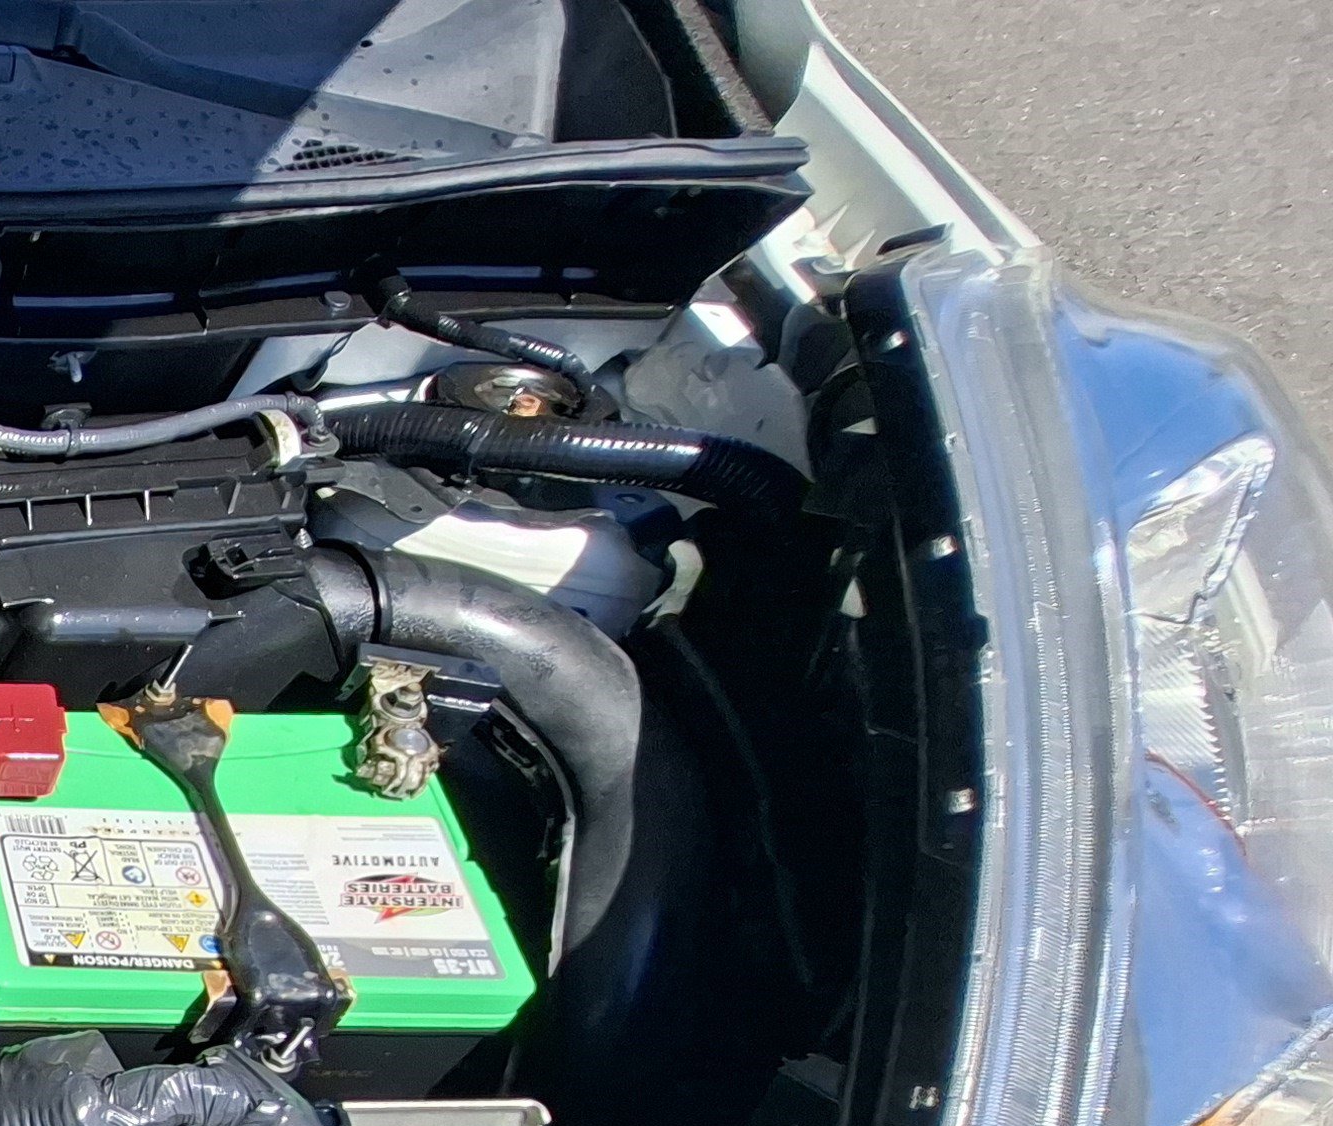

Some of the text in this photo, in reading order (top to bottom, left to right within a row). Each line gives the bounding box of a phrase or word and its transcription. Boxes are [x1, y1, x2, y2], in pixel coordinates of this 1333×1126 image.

[333, 855, 440, 867] AUTOMOTIVE
[348, 883, 452, 894] BATTERIES
[343, 895, 460, 906] INTERSTATE
[73, 954, 195, 969] DANGER/POISON
